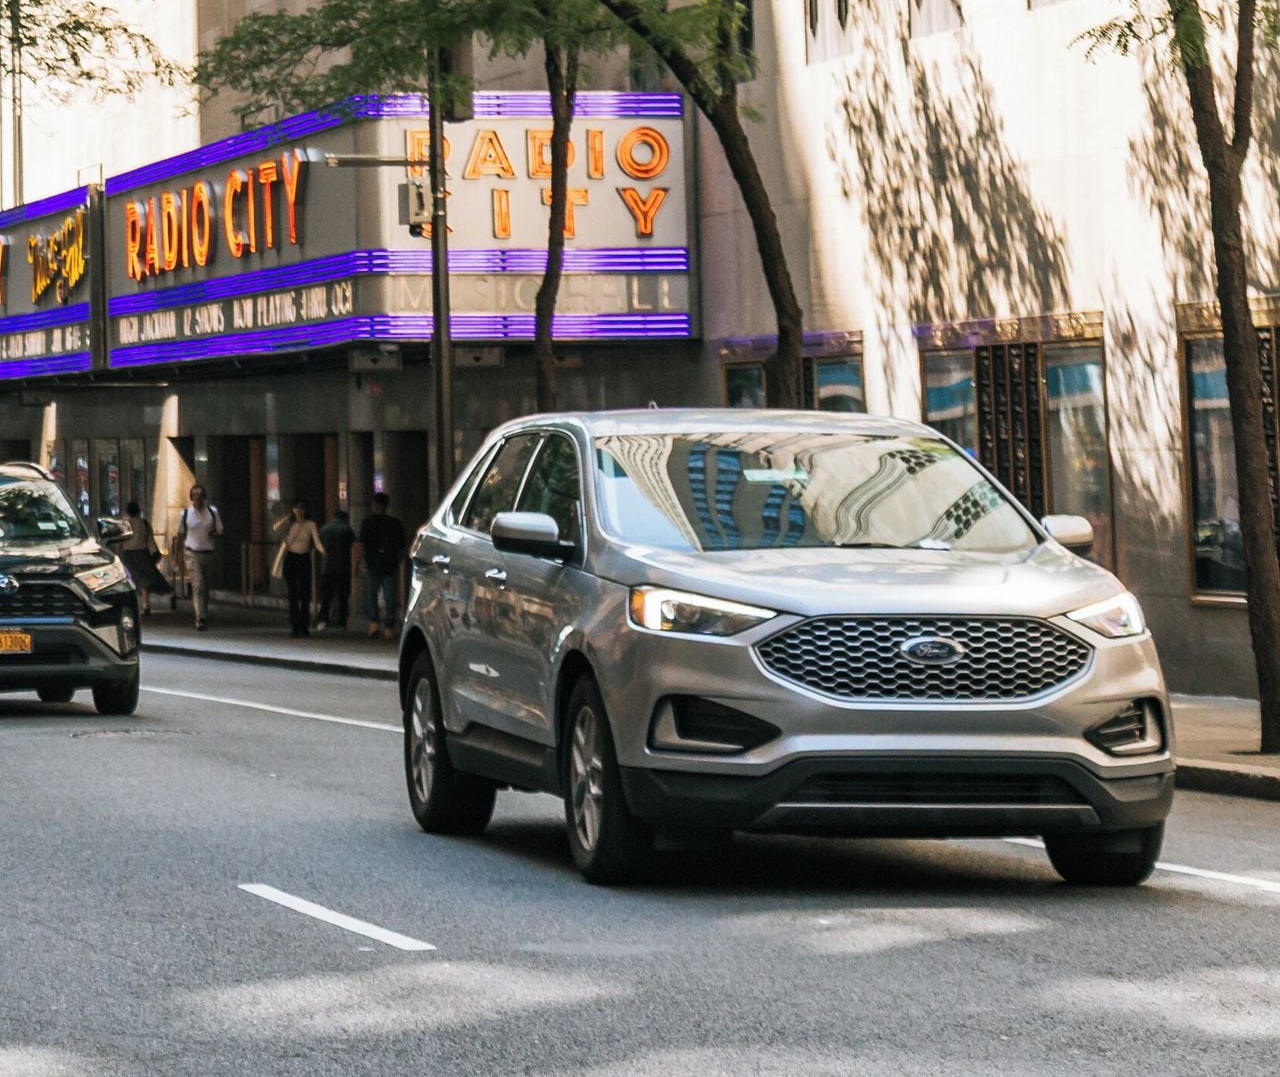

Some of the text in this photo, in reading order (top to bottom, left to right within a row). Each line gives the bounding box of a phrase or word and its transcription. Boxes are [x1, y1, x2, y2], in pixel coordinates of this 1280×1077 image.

[405, 126, 671, 181] RADIO
[126, 148, 306, 282] RADIO CITY
[415, 187, 671, 240] ITY
[257, 291, 297, 327] PLAYING
[399, 275, 540, 312] MSIC
[915, 641, 951, 658] Ford
